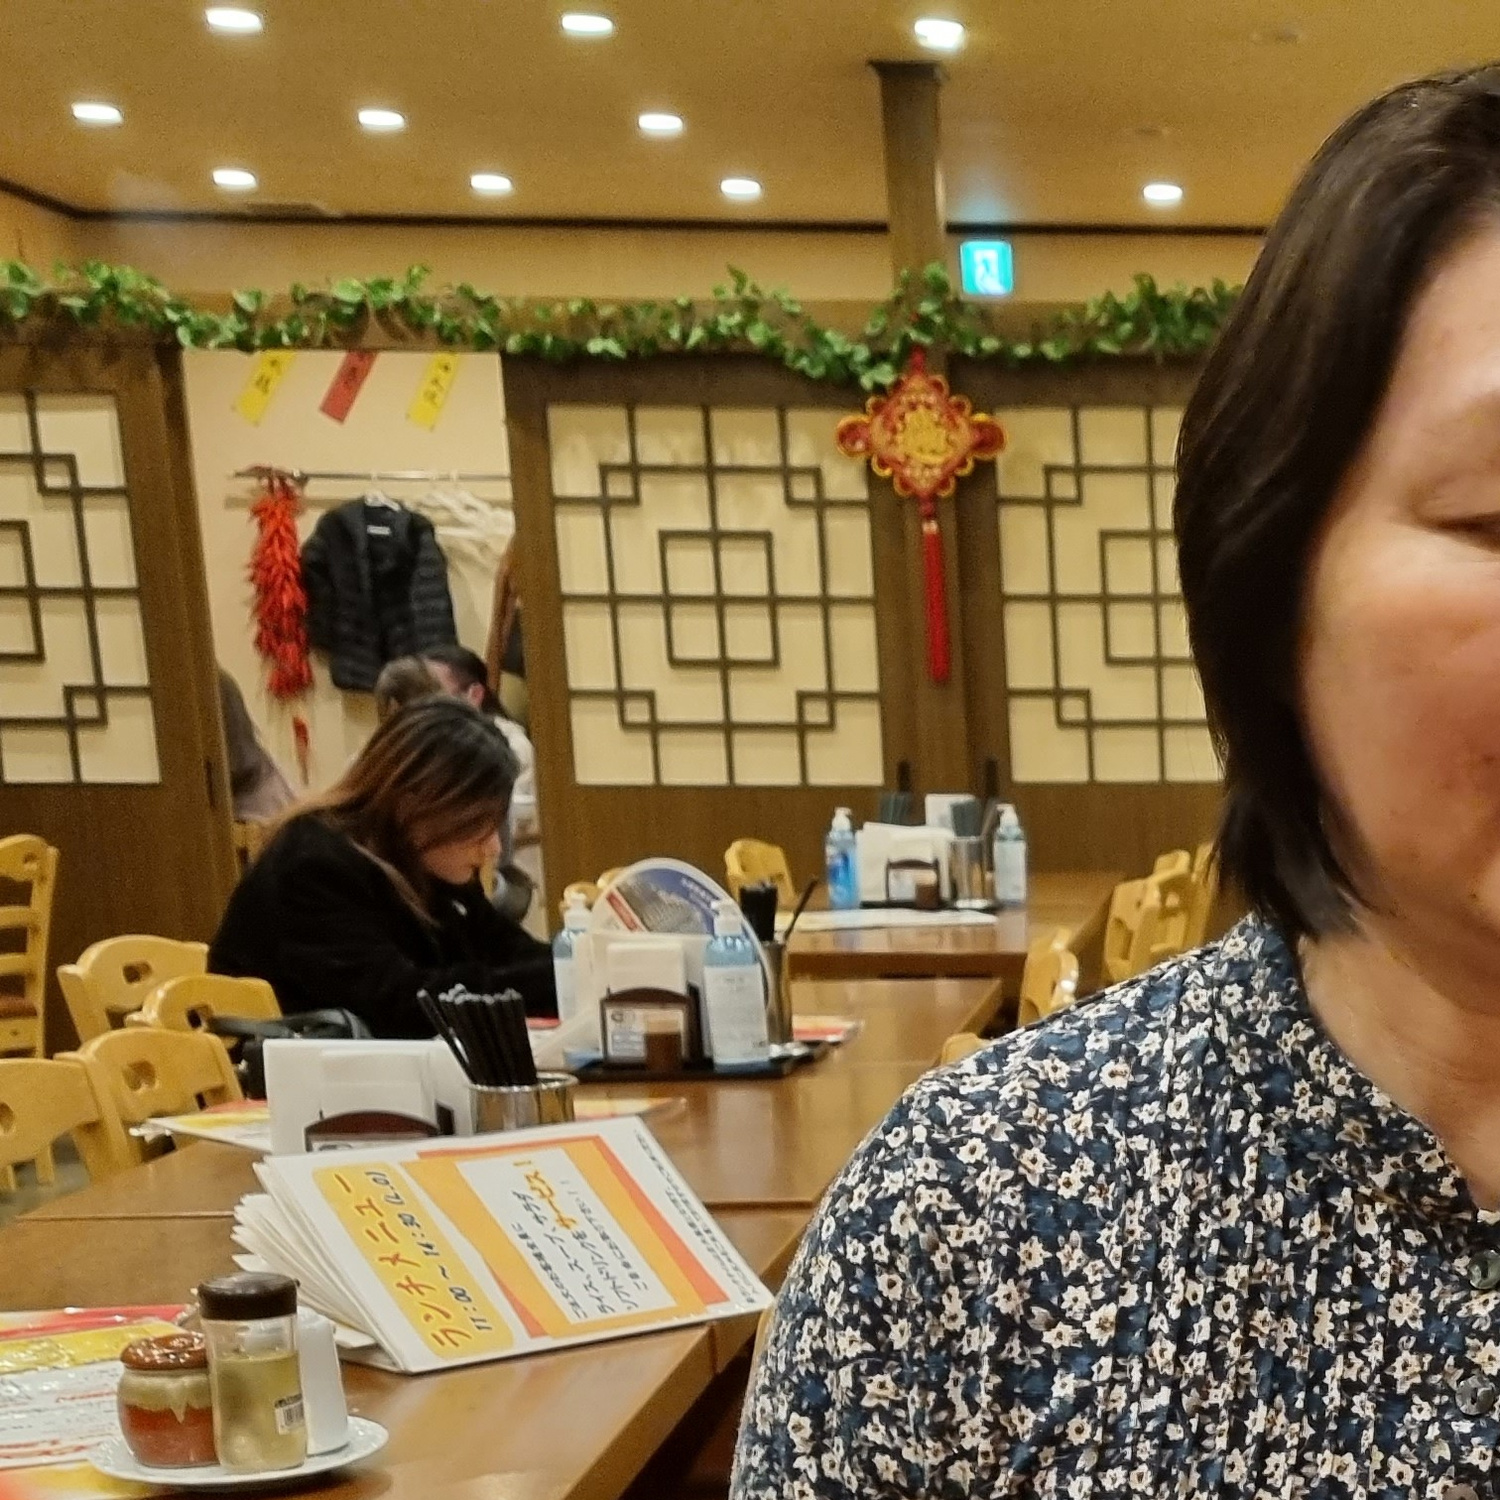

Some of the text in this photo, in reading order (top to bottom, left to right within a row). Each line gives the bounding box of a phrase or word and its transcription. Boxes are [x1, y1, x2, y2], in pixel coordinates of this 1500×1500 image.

[334, 1173, 471, 1347] ランチメニュー
